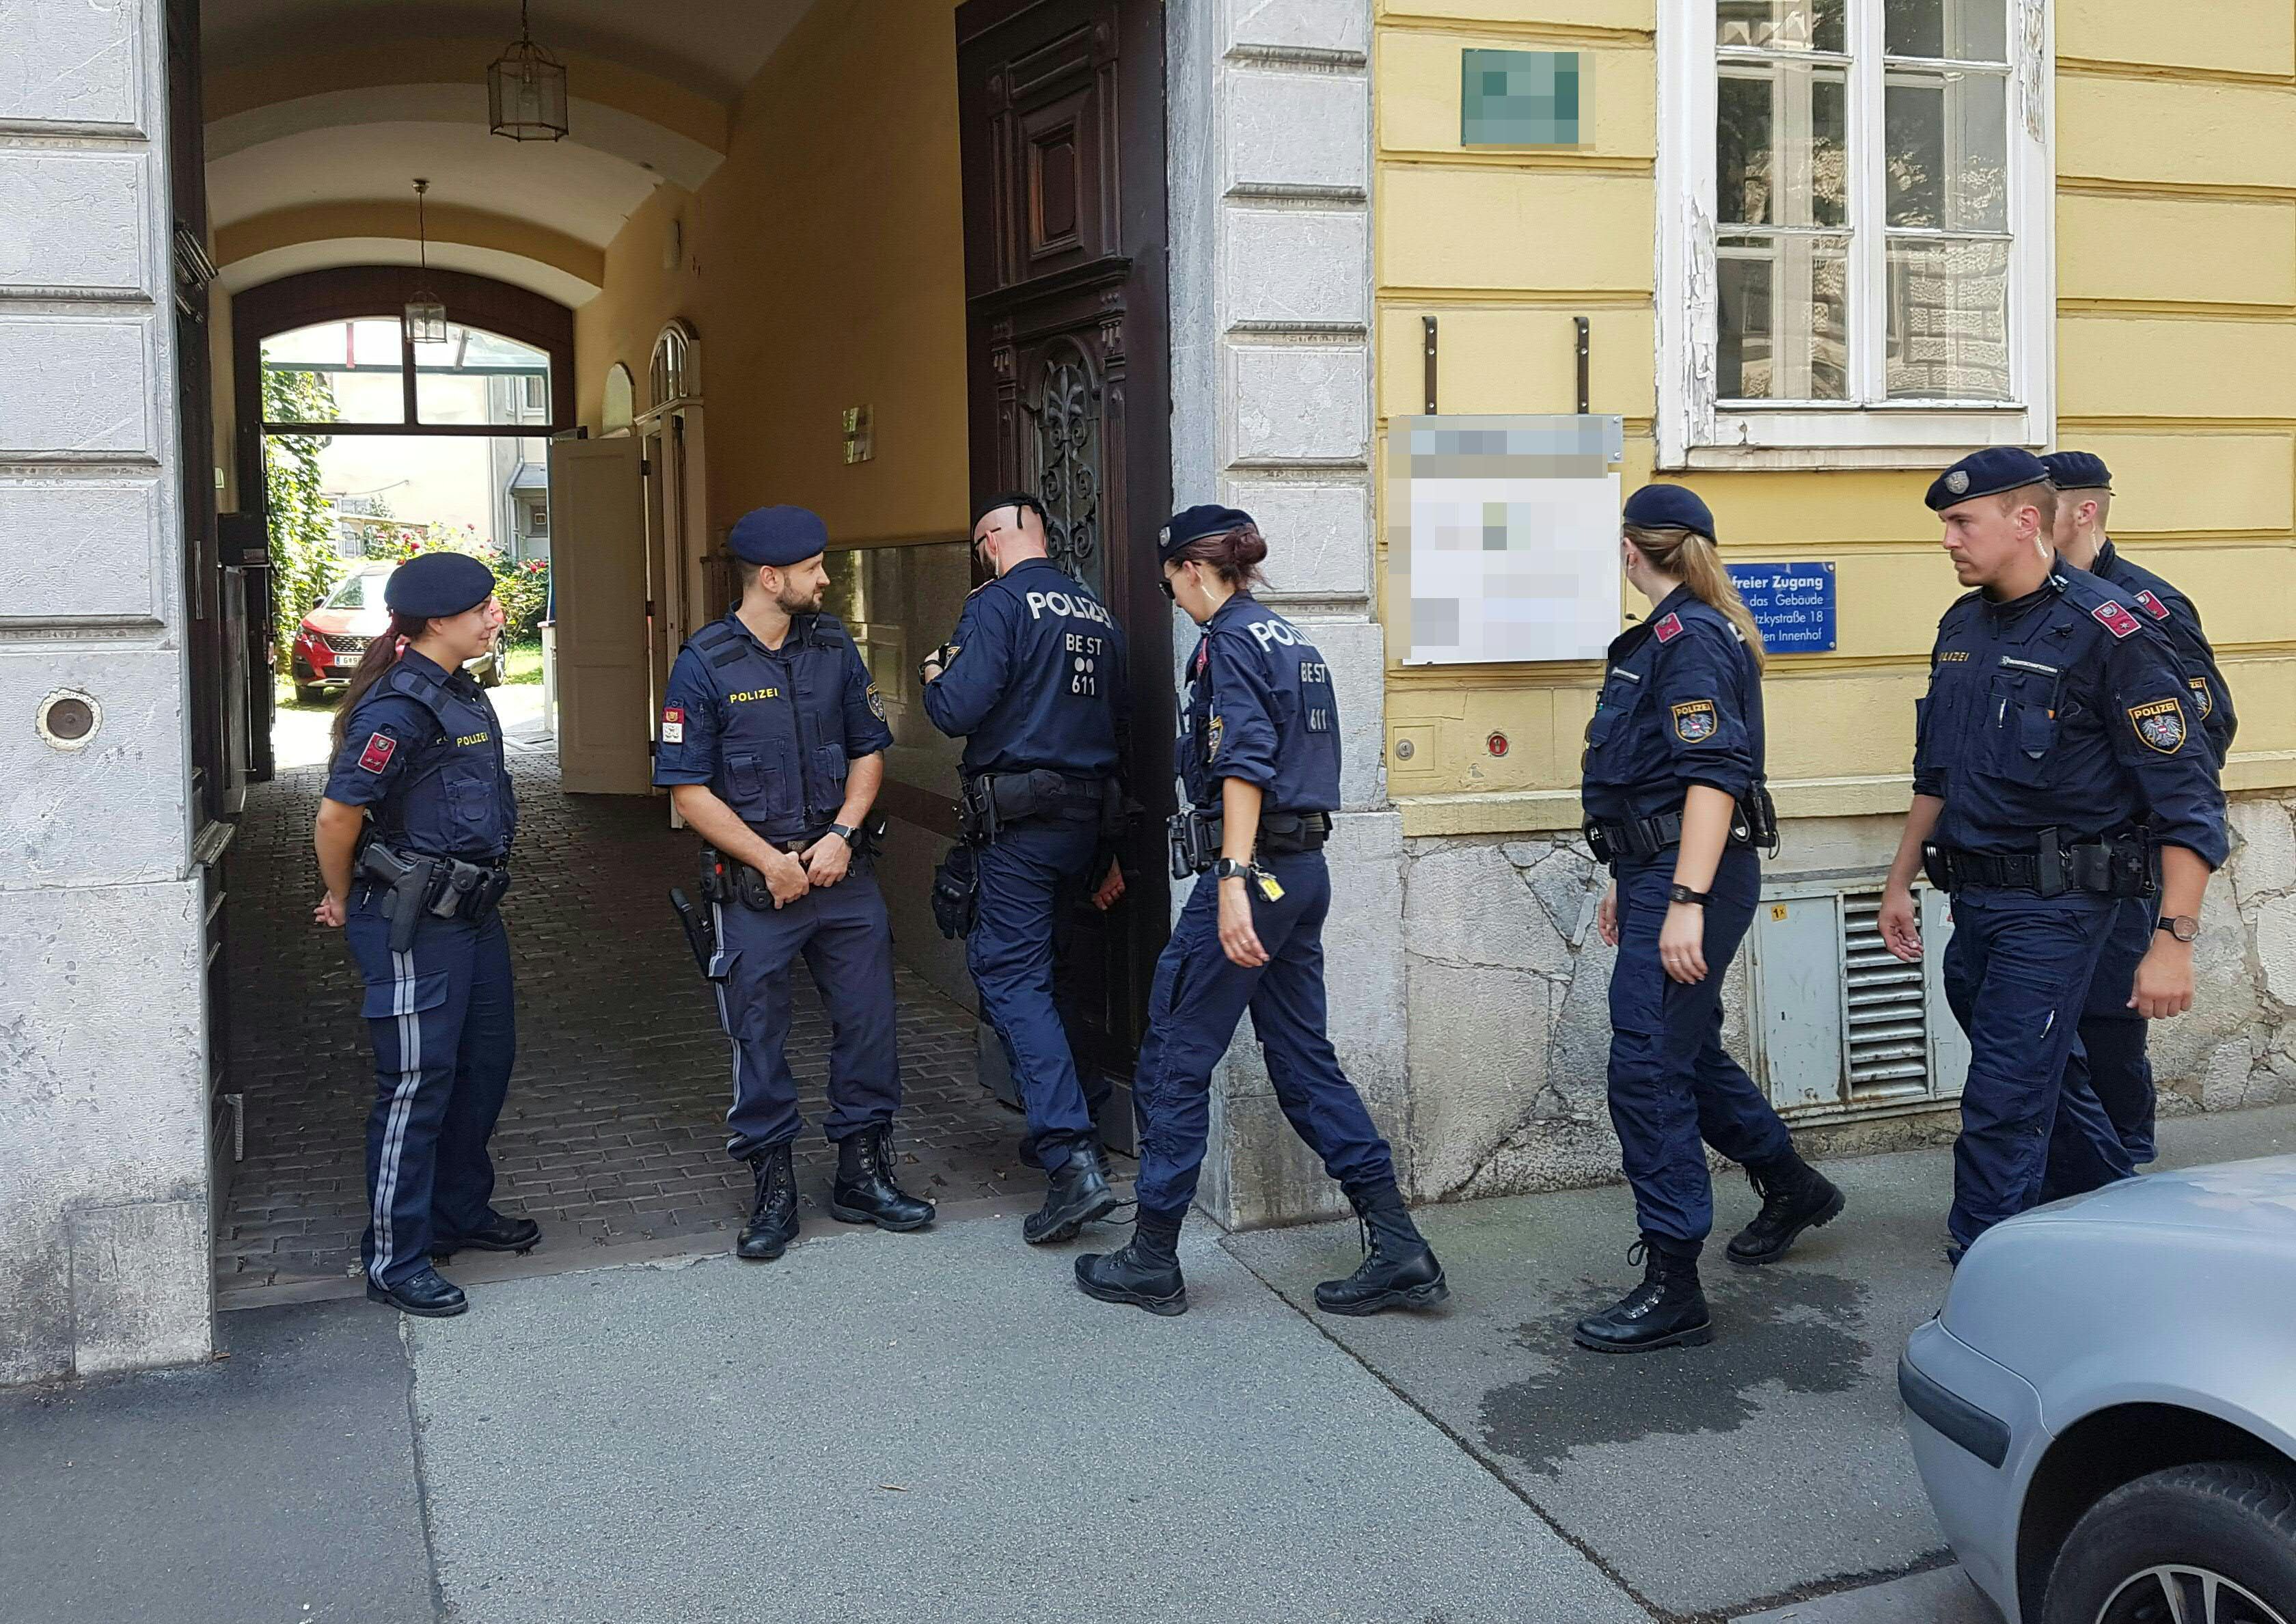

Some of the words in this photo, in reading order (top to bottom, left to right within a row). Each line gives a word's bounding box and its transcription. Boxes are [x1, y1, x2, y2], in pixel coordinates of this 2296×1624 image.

[1772, 576, 1823, 590] Zugang
[1749, 594, 1768, 606] das
[1775, 593, 1823, 606] Gebäude
[1753, 610, 1806, 627] tzkystraße
[1810, 610, 1823, 622] 18
[1779, 627, 1822, 641] Innenhof
[1071, 675, 1095, 695] 611
[730, 688, 778, 703] POLIZEI
[1676, 703, 1711, 716] POLIZEI
[2133, 702, 2176, 719] POLIZEI
[1311, 708, 1326, 730] 611
[456, 731, 489, 748] POLIZEI
